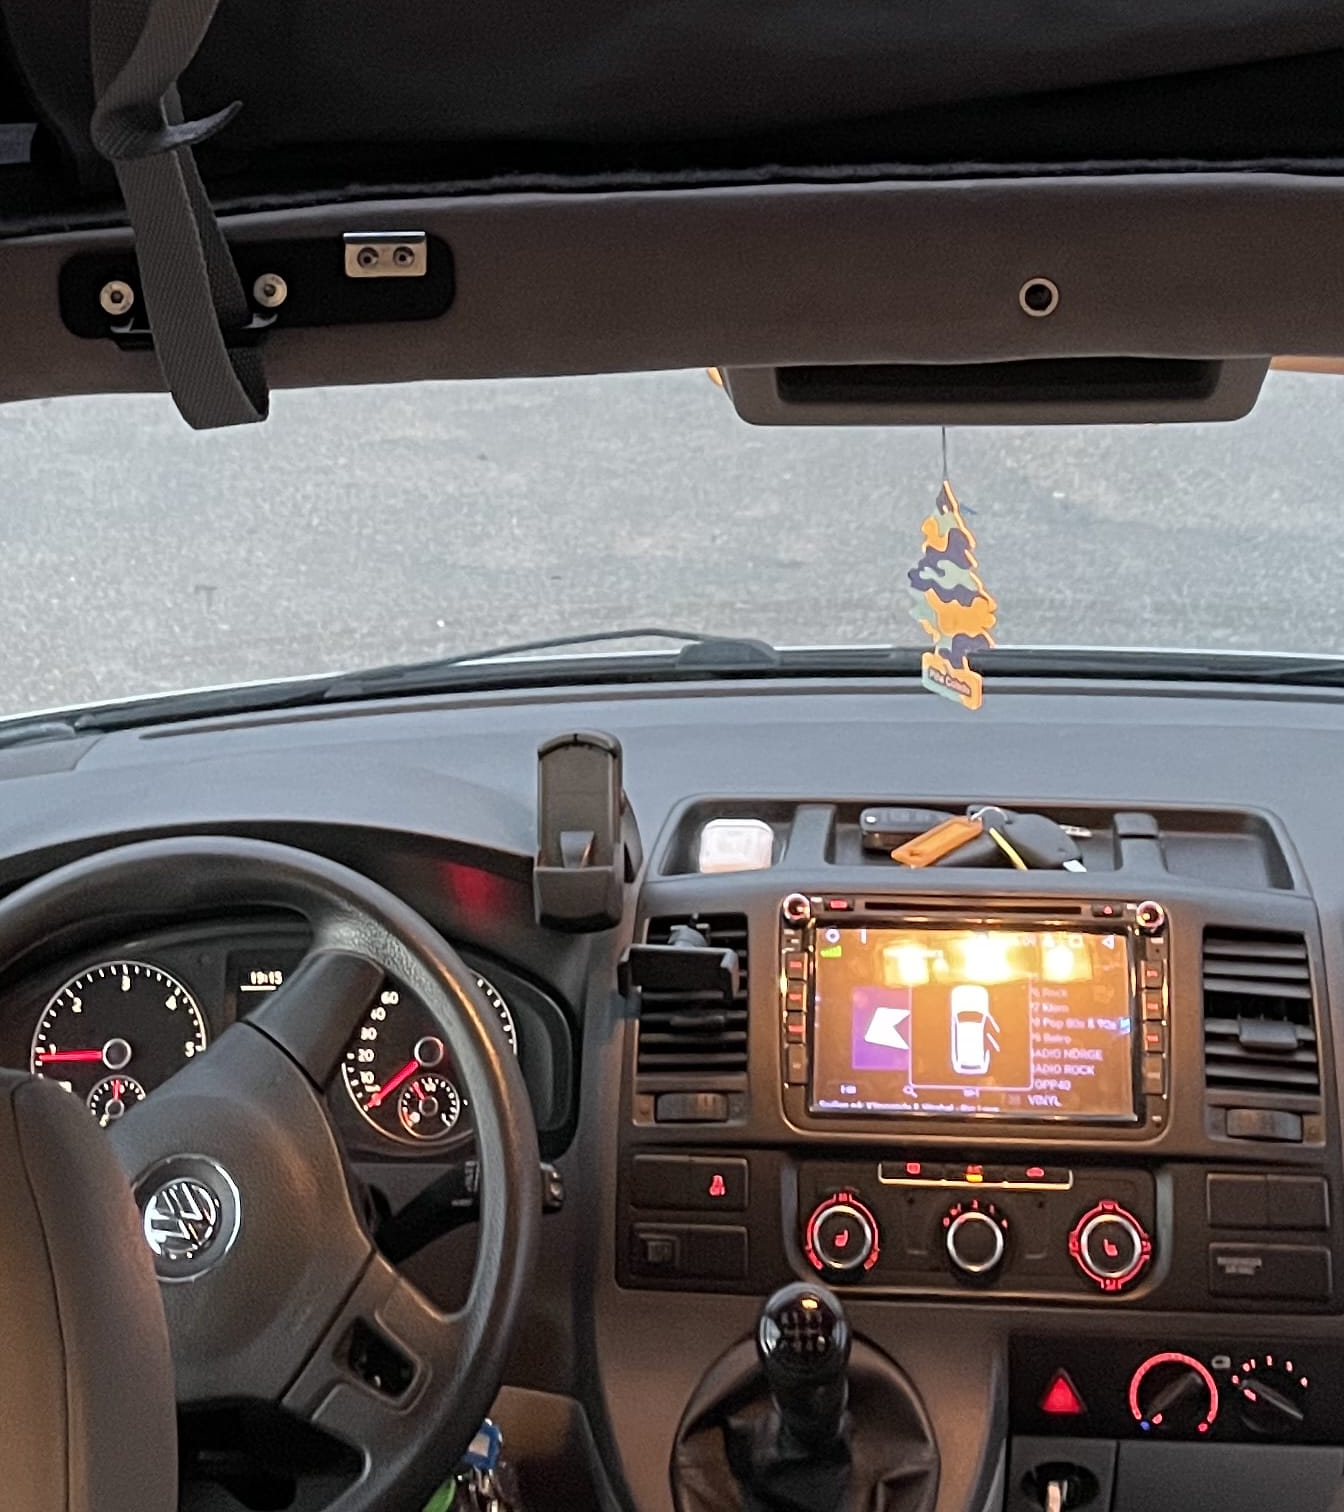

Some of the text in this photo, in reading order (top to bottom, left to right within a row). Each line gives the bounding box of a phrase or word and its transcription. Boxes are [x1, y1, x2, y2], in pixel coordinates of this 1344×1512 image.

[122, 975, 131, 991] 3
[250, 970, 283, 985] 19:15
[72, 997, 82, 1013] 2
[165, 995, 177, 1011] 4
[380, 991, 399, 1005] 60
[370, 1006, 386, 1021] 40
[361, 1027, 377, 1041] 30
[185, 1041, 195, 1058] 5
[358, 1048, 375, 1062] 20
[1063, 1048, 1103, 1061] NORGE
[1064, 1064, 1095, 1076] ROCK
[1027, 1093, 1062, 1107] VINYL
